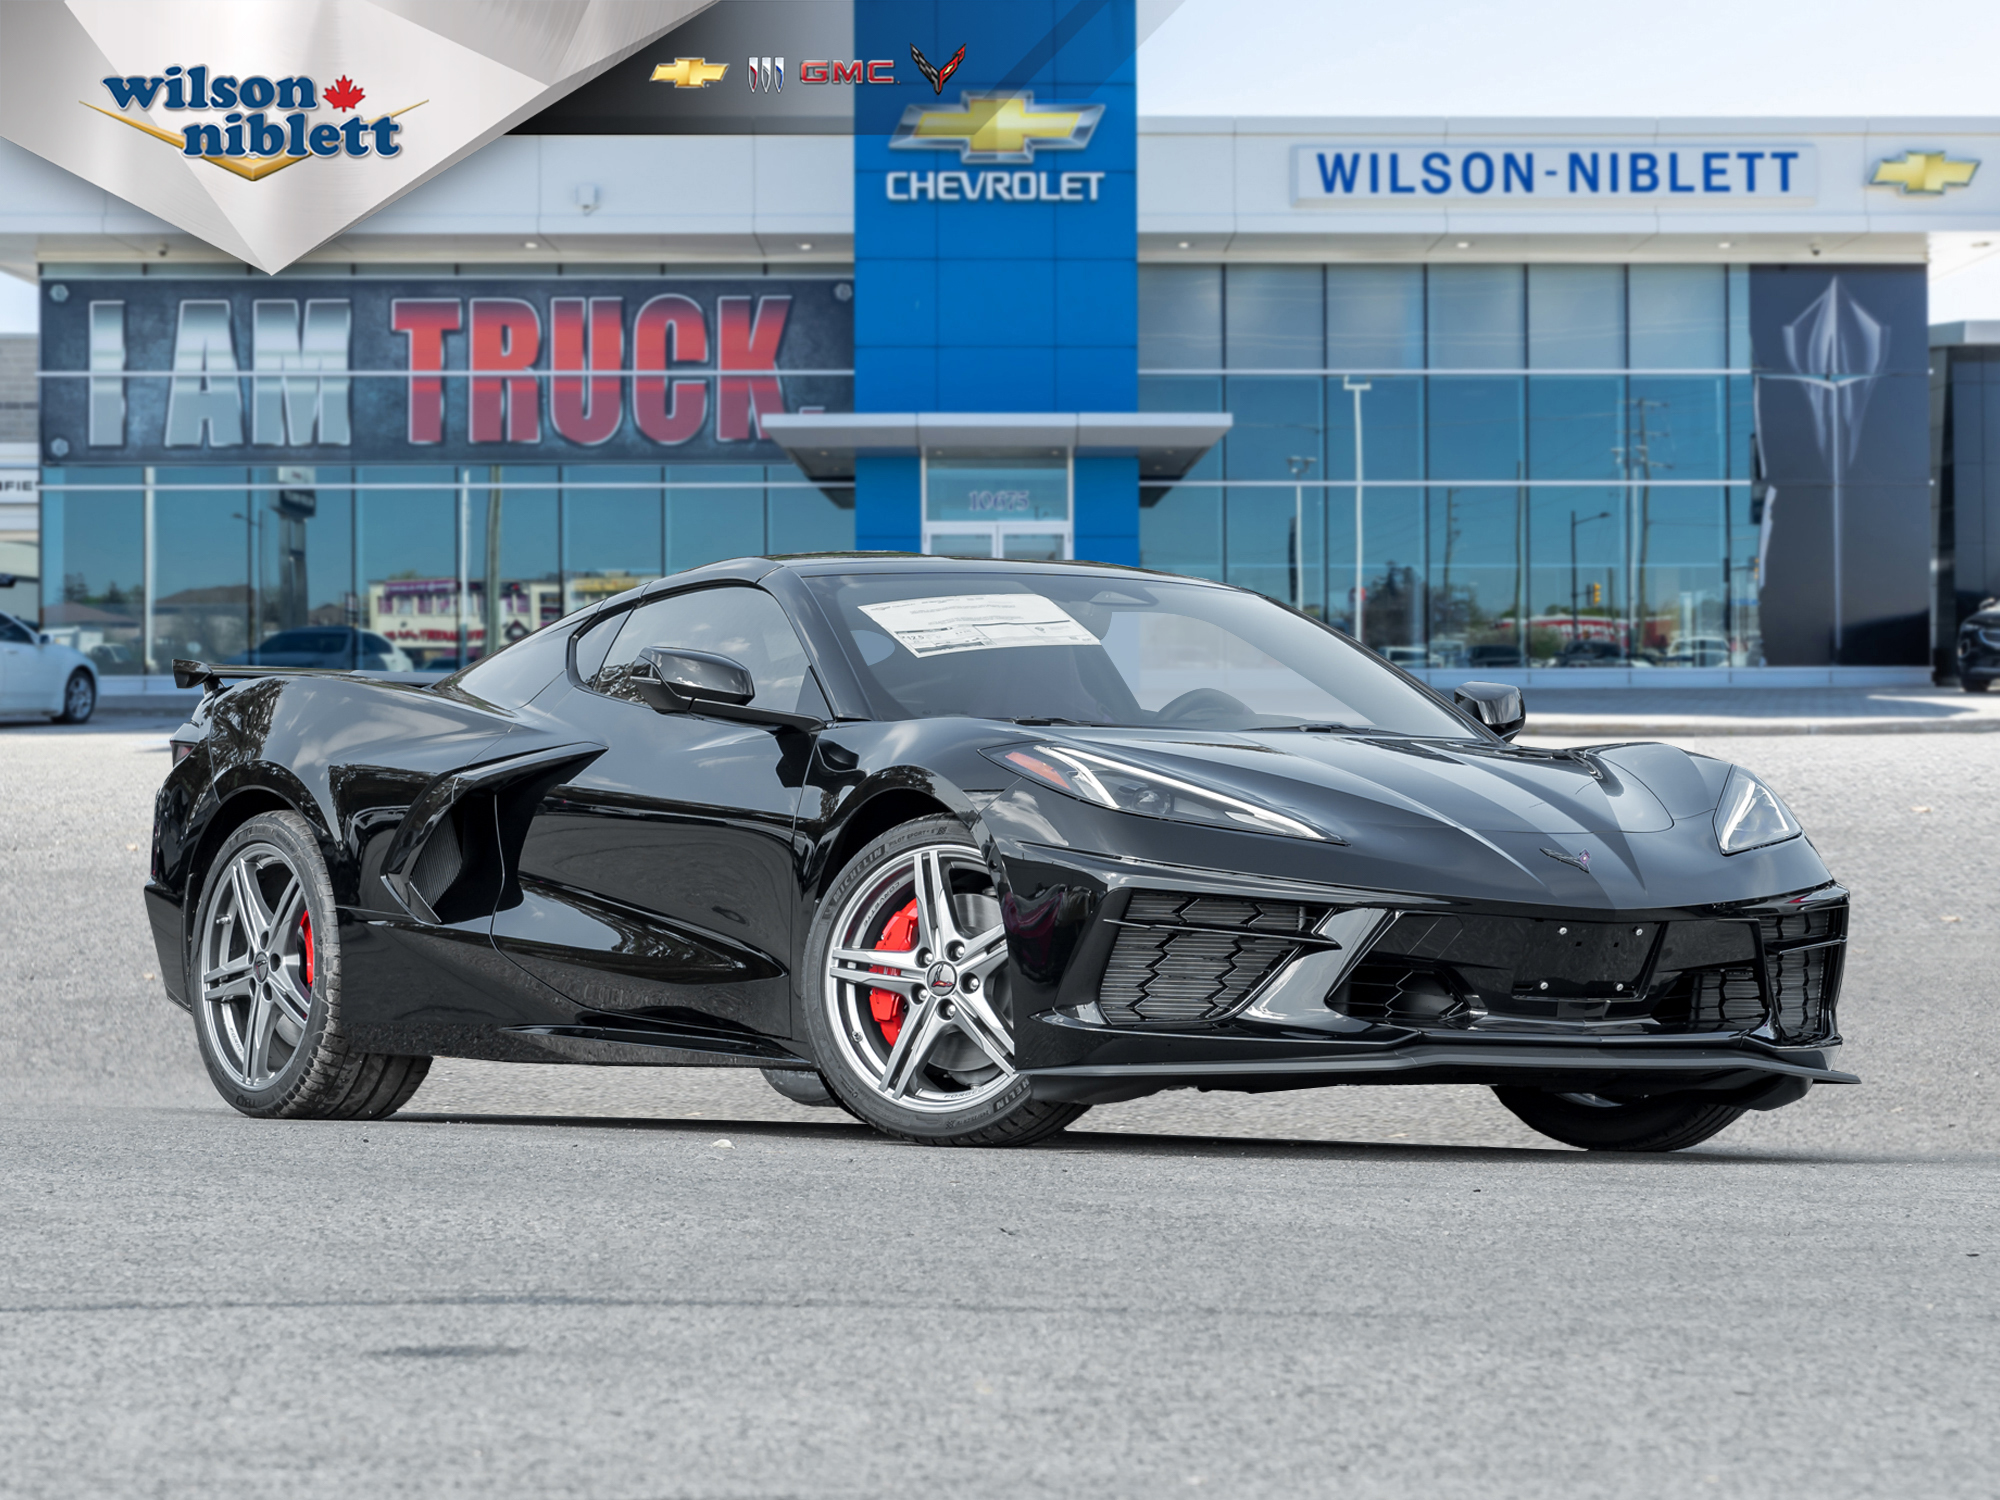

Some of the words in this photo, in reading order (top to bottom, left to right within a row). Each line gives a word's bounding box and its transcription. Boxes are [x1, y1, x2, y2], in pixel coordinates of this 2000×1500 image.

[885, 171, 1105, 201] CHEVROLET
[1316, 152, 1800, 194] WILSON-NIBLETT
[89, 300, 126, 446] I
[164, 299, 351, 447] AM
[391, 294, 824, 445] TRUCK
[968, 490, 1030, 512] 10675
[832, 846, 884, 903] MICHELIN
[996, 1078, 1030, 1110] HELIN
